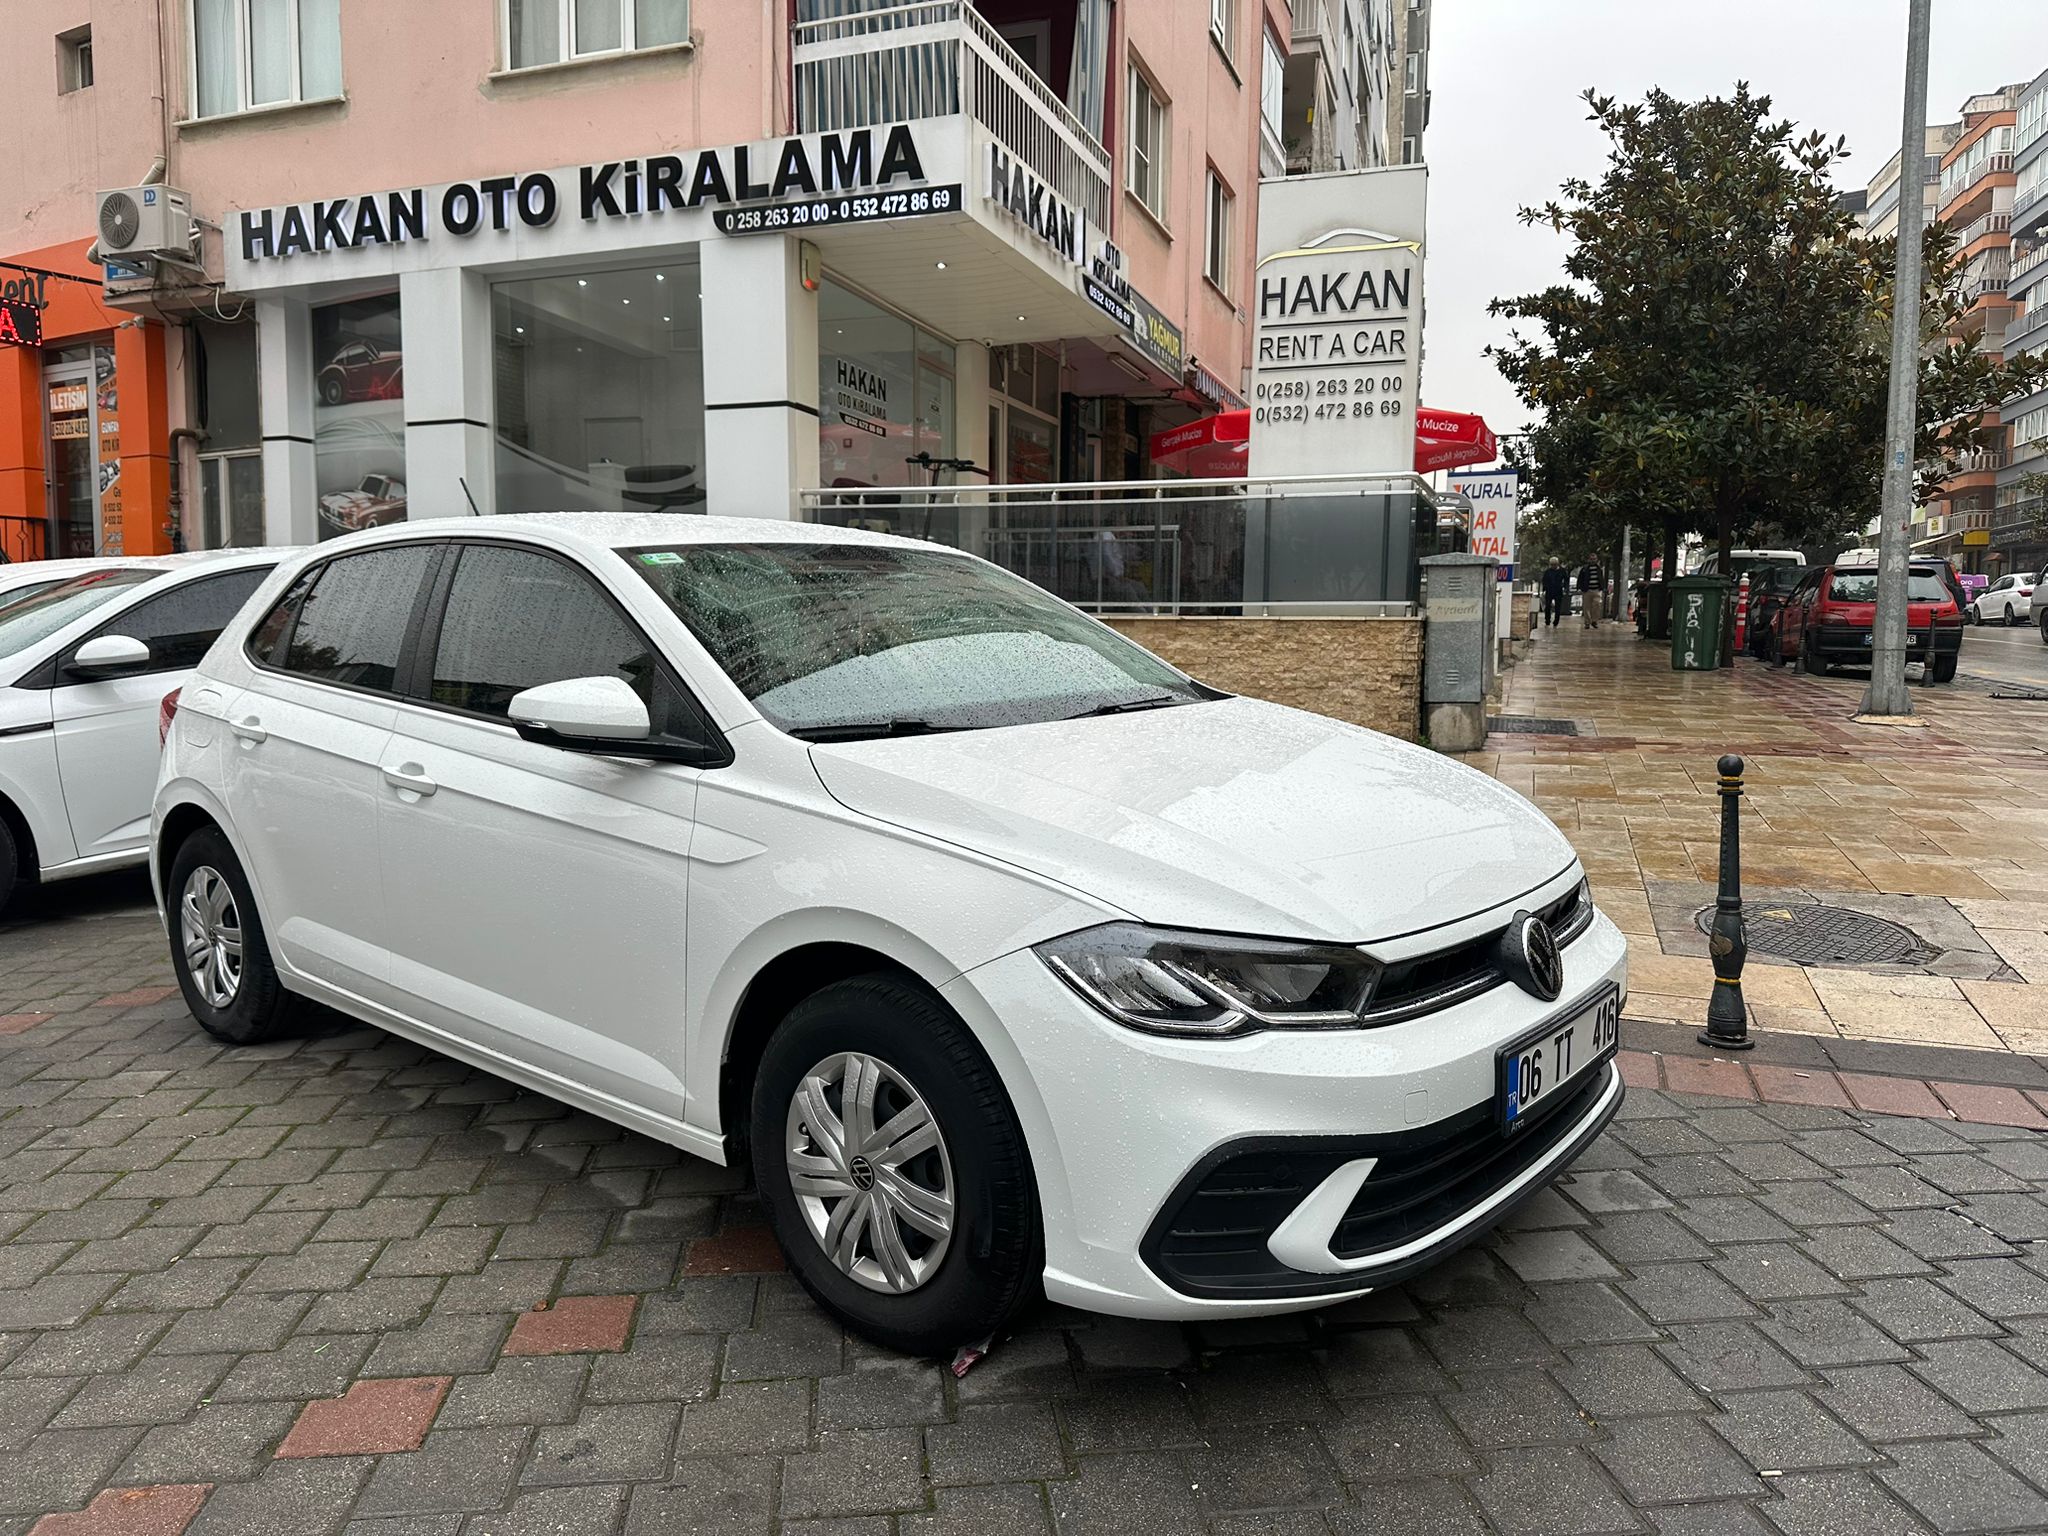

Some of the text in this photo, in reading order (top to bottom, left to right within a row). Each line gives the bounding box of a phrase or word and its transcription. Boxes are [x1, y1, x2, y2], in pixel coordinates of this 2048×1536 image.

[725, 213, 734, 230] 0
[737, 211, 761, 229] 258
[765, 209, 789, 226] 263
[792, 206, 809, 223] 20
[812, 203, 829, 221] 00
[840, 201, 850, 218] 0
[852, 197, 878, 216] 532
[881, 195, 908, 214] 472
[911, 192, 928, 211] 86
[932, 190, 950, 208] 69
[991, 142, 1075, 262] HAKAN
[241, 189, 425, 260] HAKAN
[442, 174, 557, 235] OTO
[1105, 240, 1120, 270] OTO
[0, 273, 49, 310] ent
[1105, 297, 1116, 314] 472
[1261, 268, 1410, 317] HAKAN
[1147, 314, 1180, 360] YAĞMUR
[1260, 329, 1406, 361] RENT A CAR
[837, 360, 886, 402] HAKAN
[1257, 376, 1402, 403] 0(258) 263 20 00
[50, 386, 88, 410] İLETİŞİM
[838, 392, 852, 409] OTO
[1256, 400, 1401, 427] 0(532) 472 86 69
[1423, 418, 1459, 433] Mucize
[1461, 482, 1513, 499] KURAL
[1474, 510, 1497, 530] AR
[1471, 537, 1509, 556] NTAL
[1519, 997, 1615, 1106] 06 TT 416
[1508, 1091, 1517, 1107] TR
